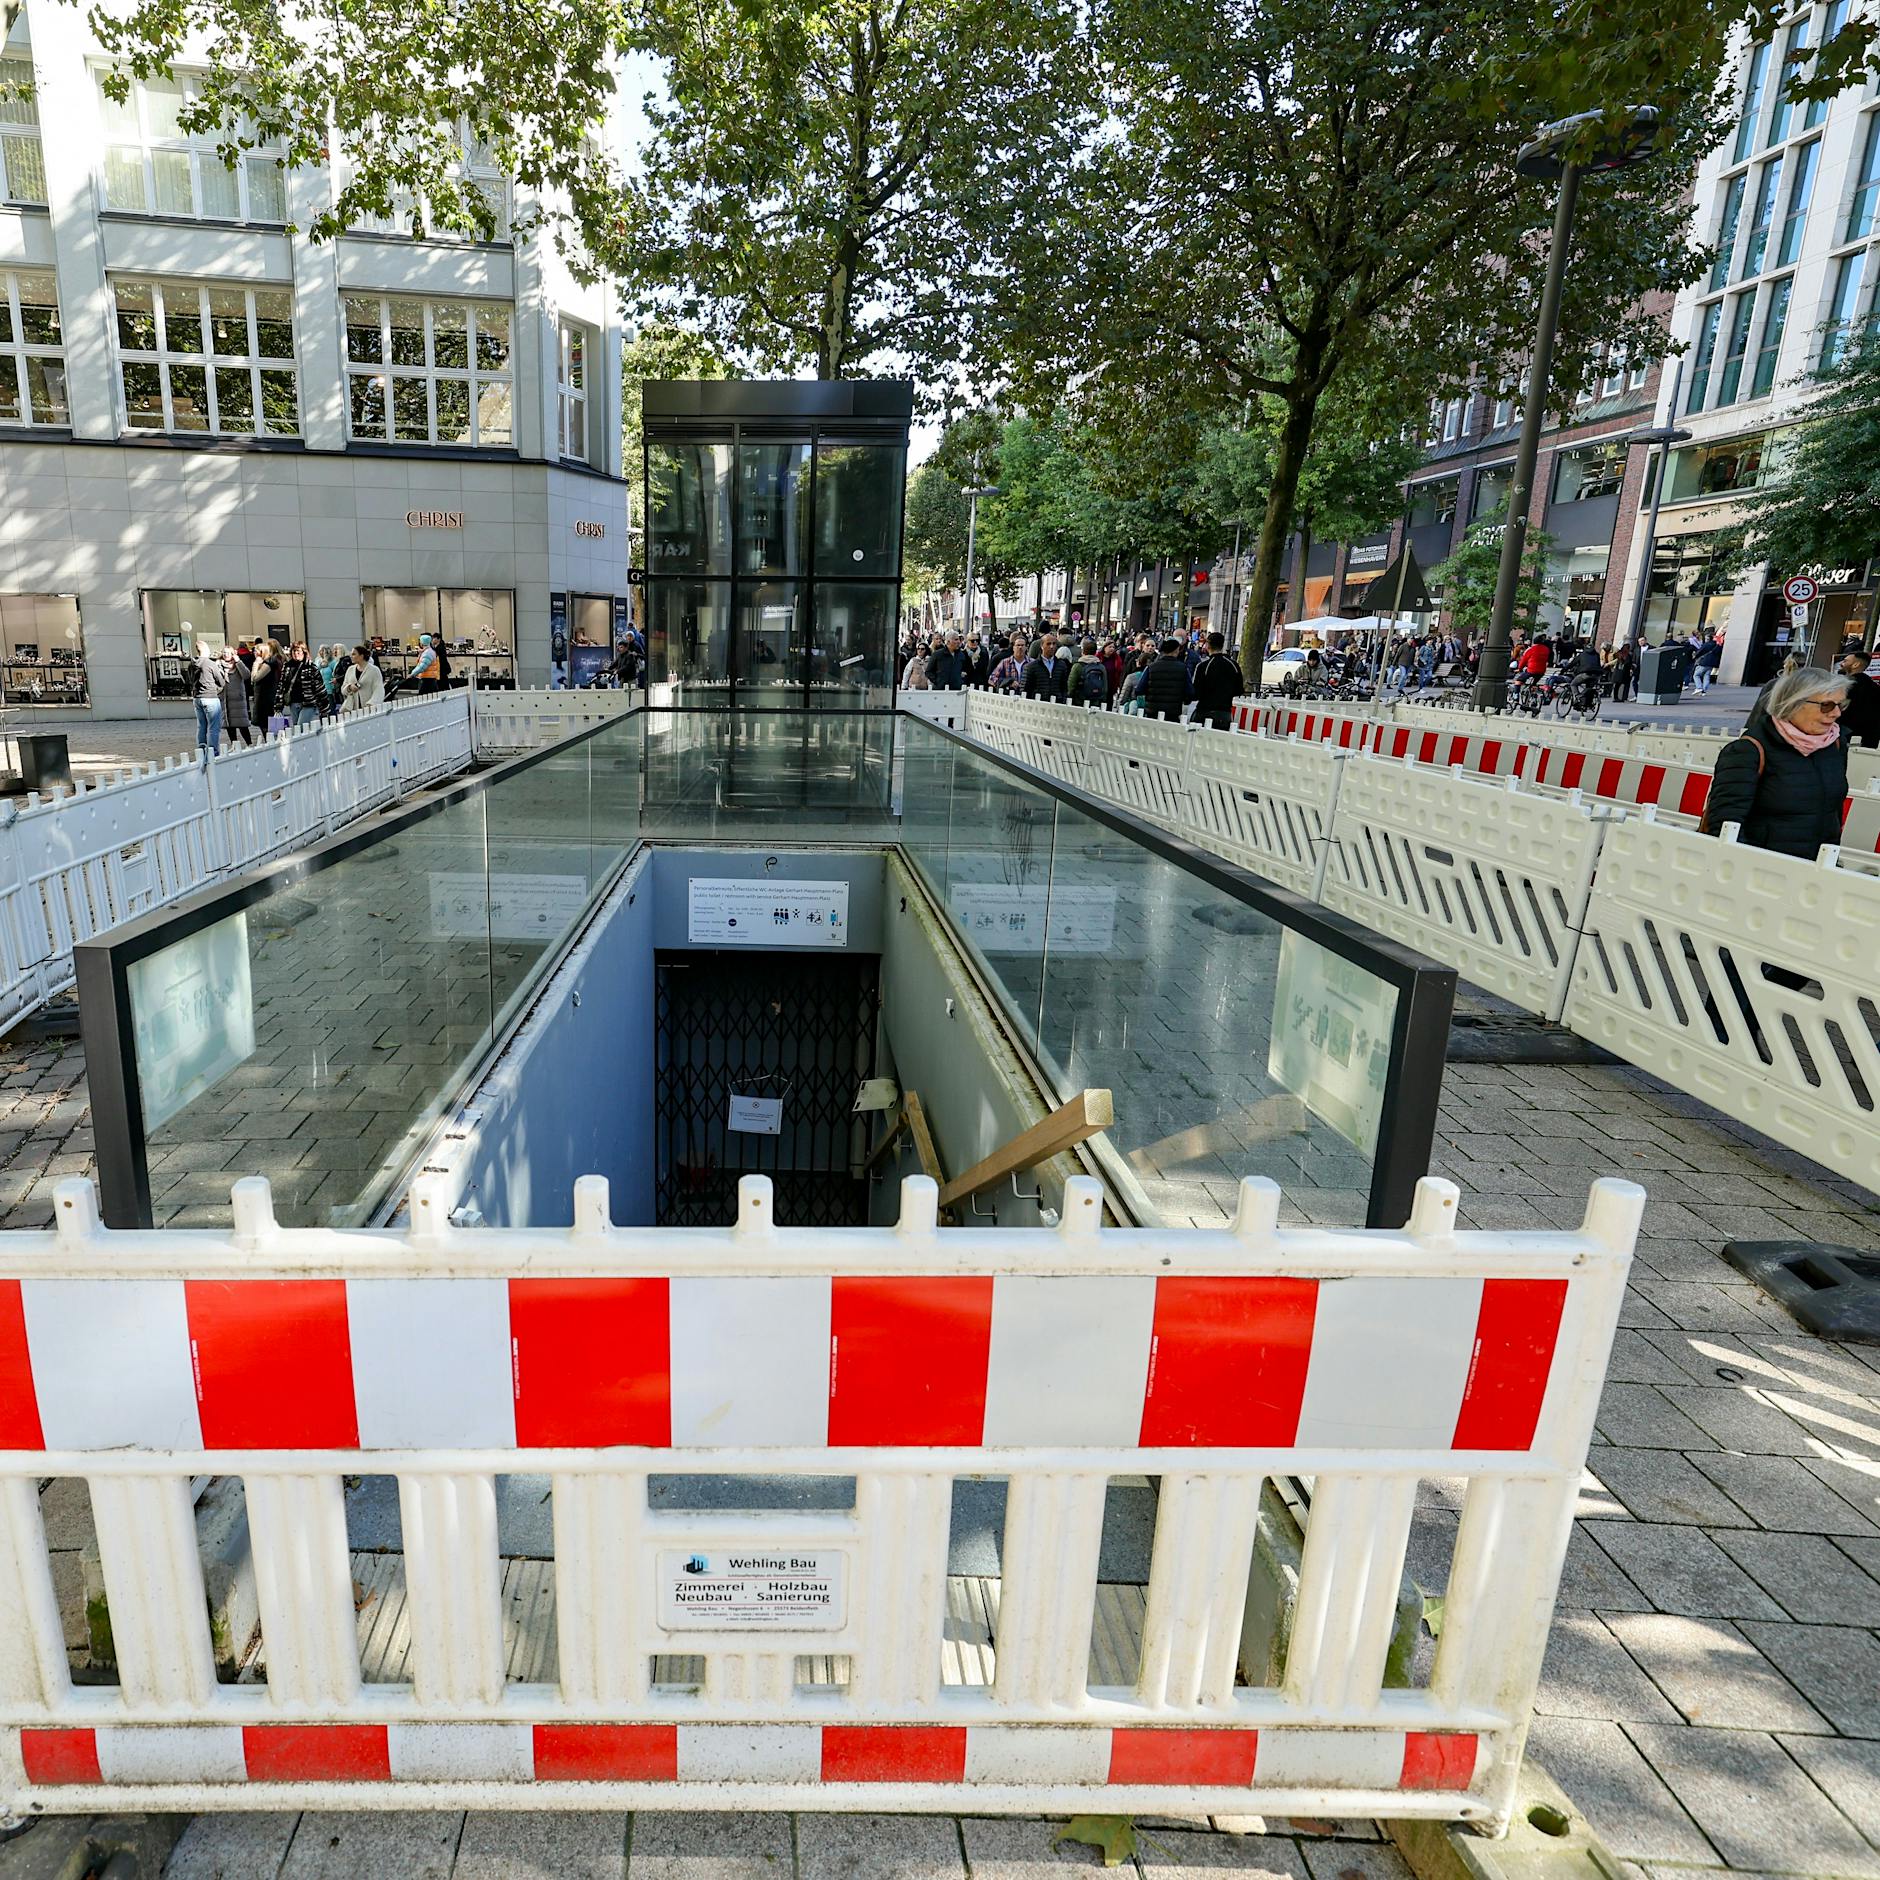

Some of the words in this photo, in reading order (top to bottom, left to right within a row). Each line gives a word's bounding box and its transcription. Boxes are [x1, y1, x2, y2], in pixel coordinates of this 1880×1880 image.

[406, 511, 465, 528] CHRIST
[575, 519, 606, 539] CHRIST
[1791, 583, 1811, 597] 25
[729, 1558, 786, 1570] Wehling
[790, 1558, 816, 1568] Bau
[675, 1582, 744, 1592] Zimmerei
[769, 1582, 828, 1591] Holzbau
[675, 1592, 732, 1601] Neubau
[757, 1592, 830, 1603] Sanierung
